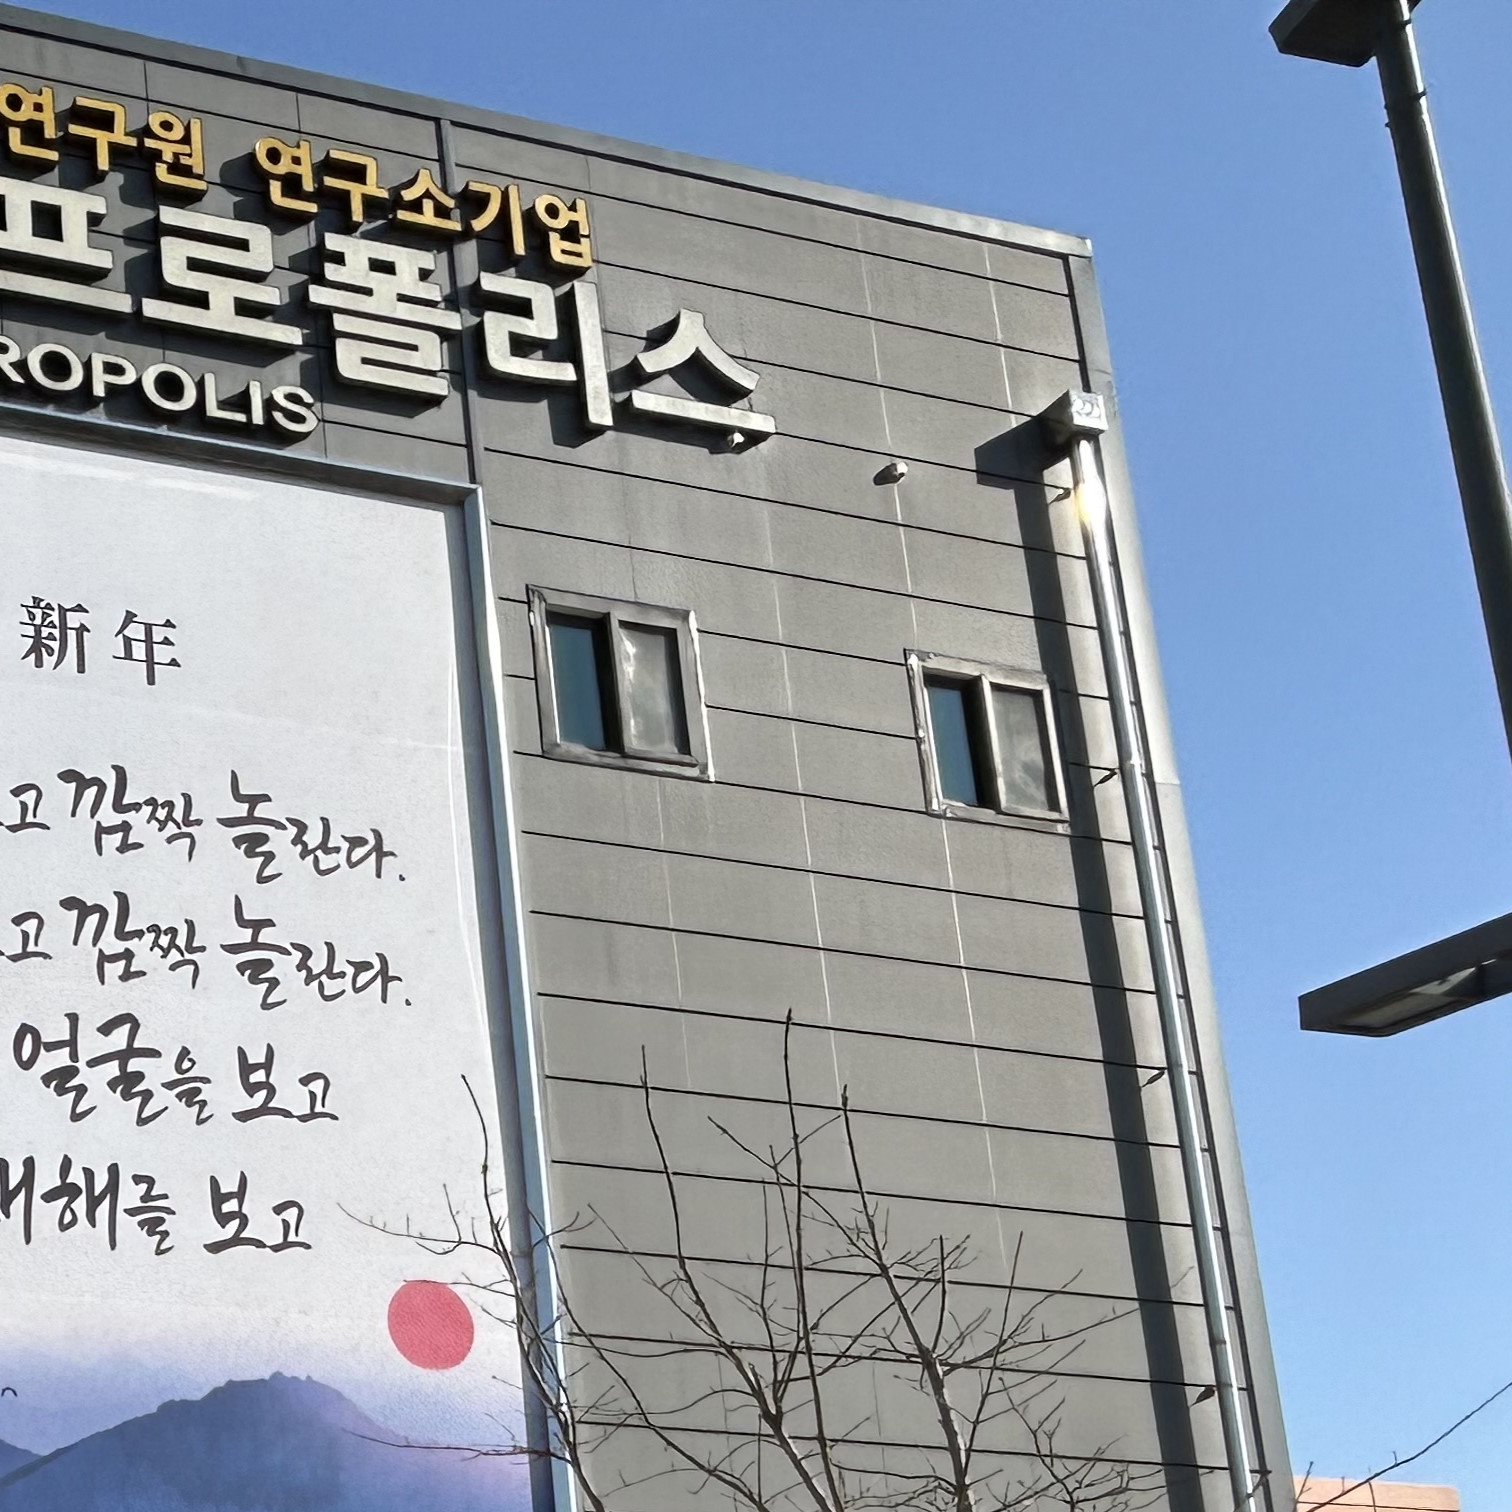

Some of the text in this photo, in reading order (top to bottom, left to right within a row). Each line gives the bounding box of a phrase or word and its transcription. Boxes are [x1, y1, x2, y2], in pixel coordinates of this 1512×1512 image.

[253, 134, 596, 270] 연구소기업
[58, 763, 204, 863] 깜짝
[216, 768, 407, 885] 놀란다.
[59, 889, 207, 991] 깜짝
[219, 893, 412, 1012] 놀란다.
[11, 1011, 215, 1128] 얼굴을
[231, 1042, 340, 1124] 보고
[203, 1169, 313, 1256] 보고
